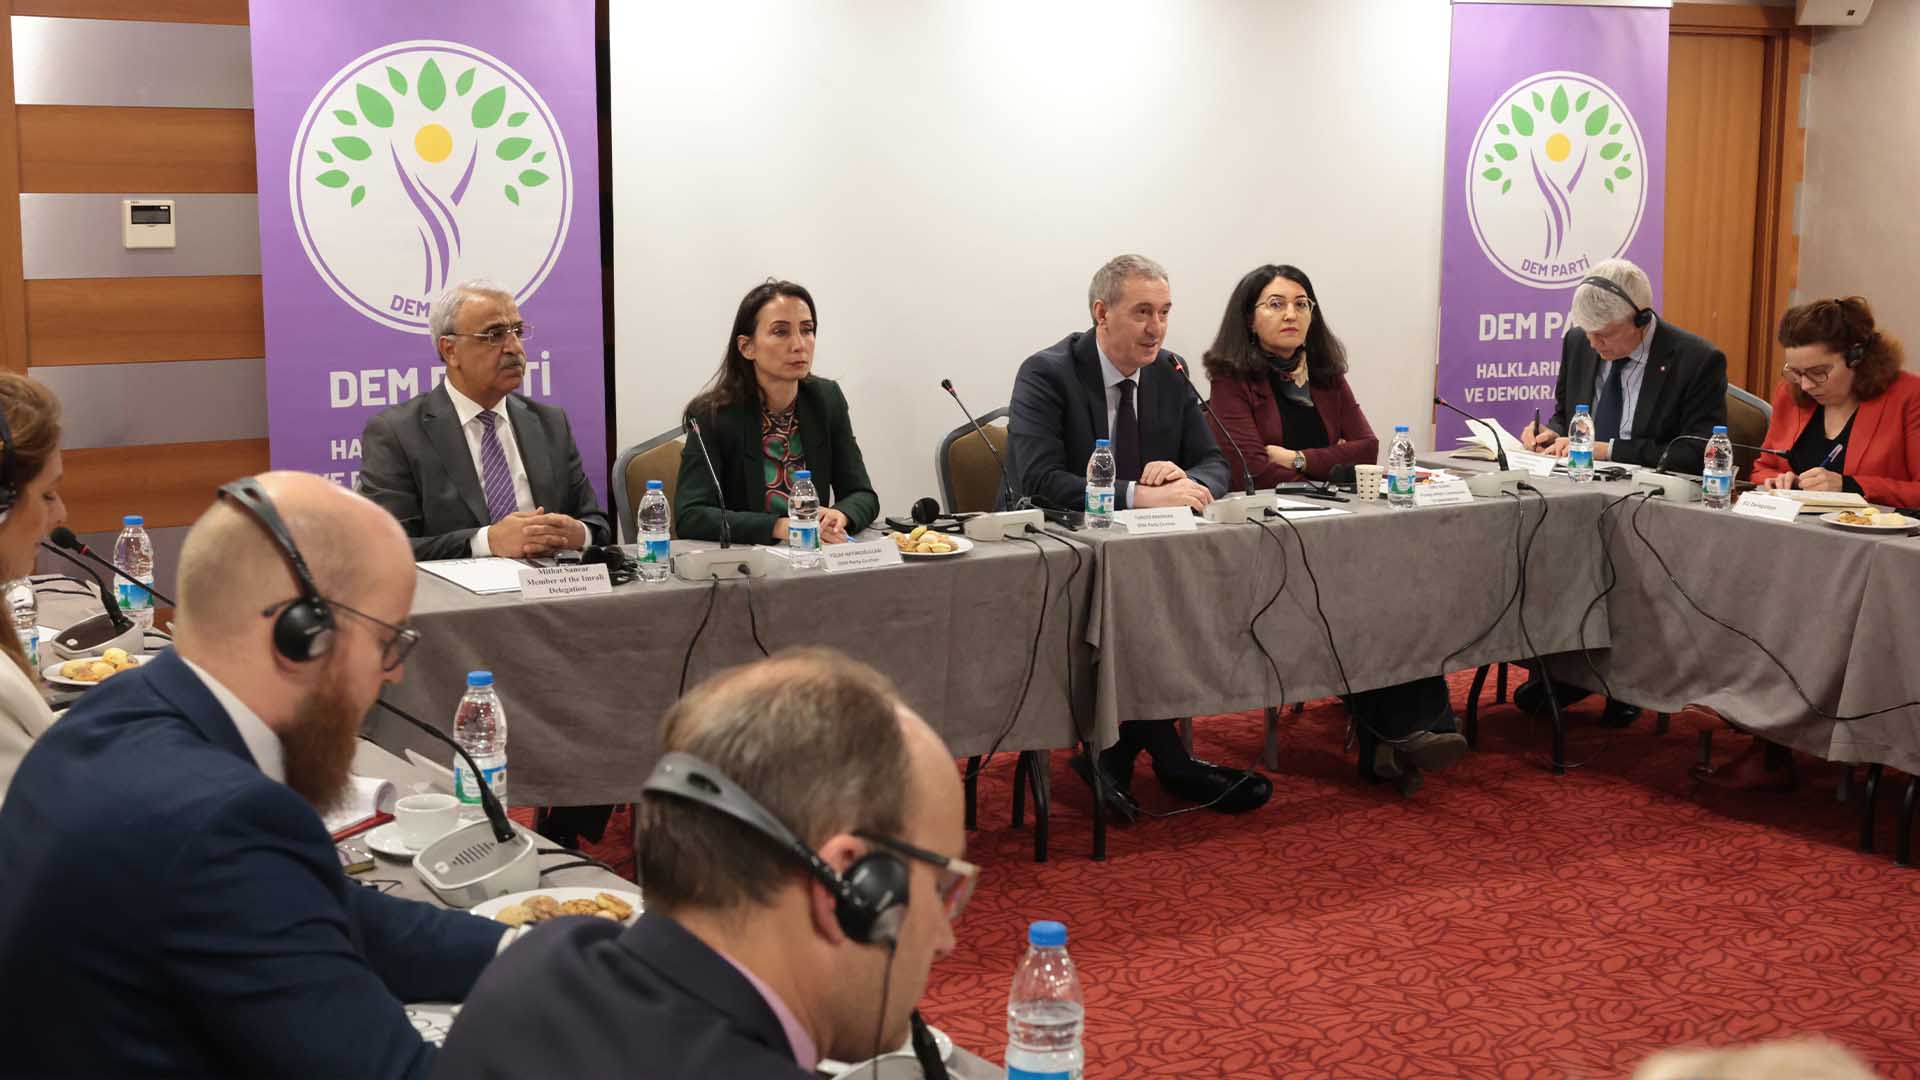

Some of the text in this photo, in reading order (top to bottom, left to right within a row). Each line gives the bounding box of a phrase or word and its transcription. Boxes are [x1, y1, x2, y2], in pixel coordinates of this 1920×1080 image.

[1521, 254, 1590, 277] DEM PARTİ
[390, 294, 431, 318] DEM
[1479, 312, 1536, 341] DEM
[329, 367, 419, 409] DEM
[1464, 387, 1484, 403] VE
[568, 575, 579, 583] the
